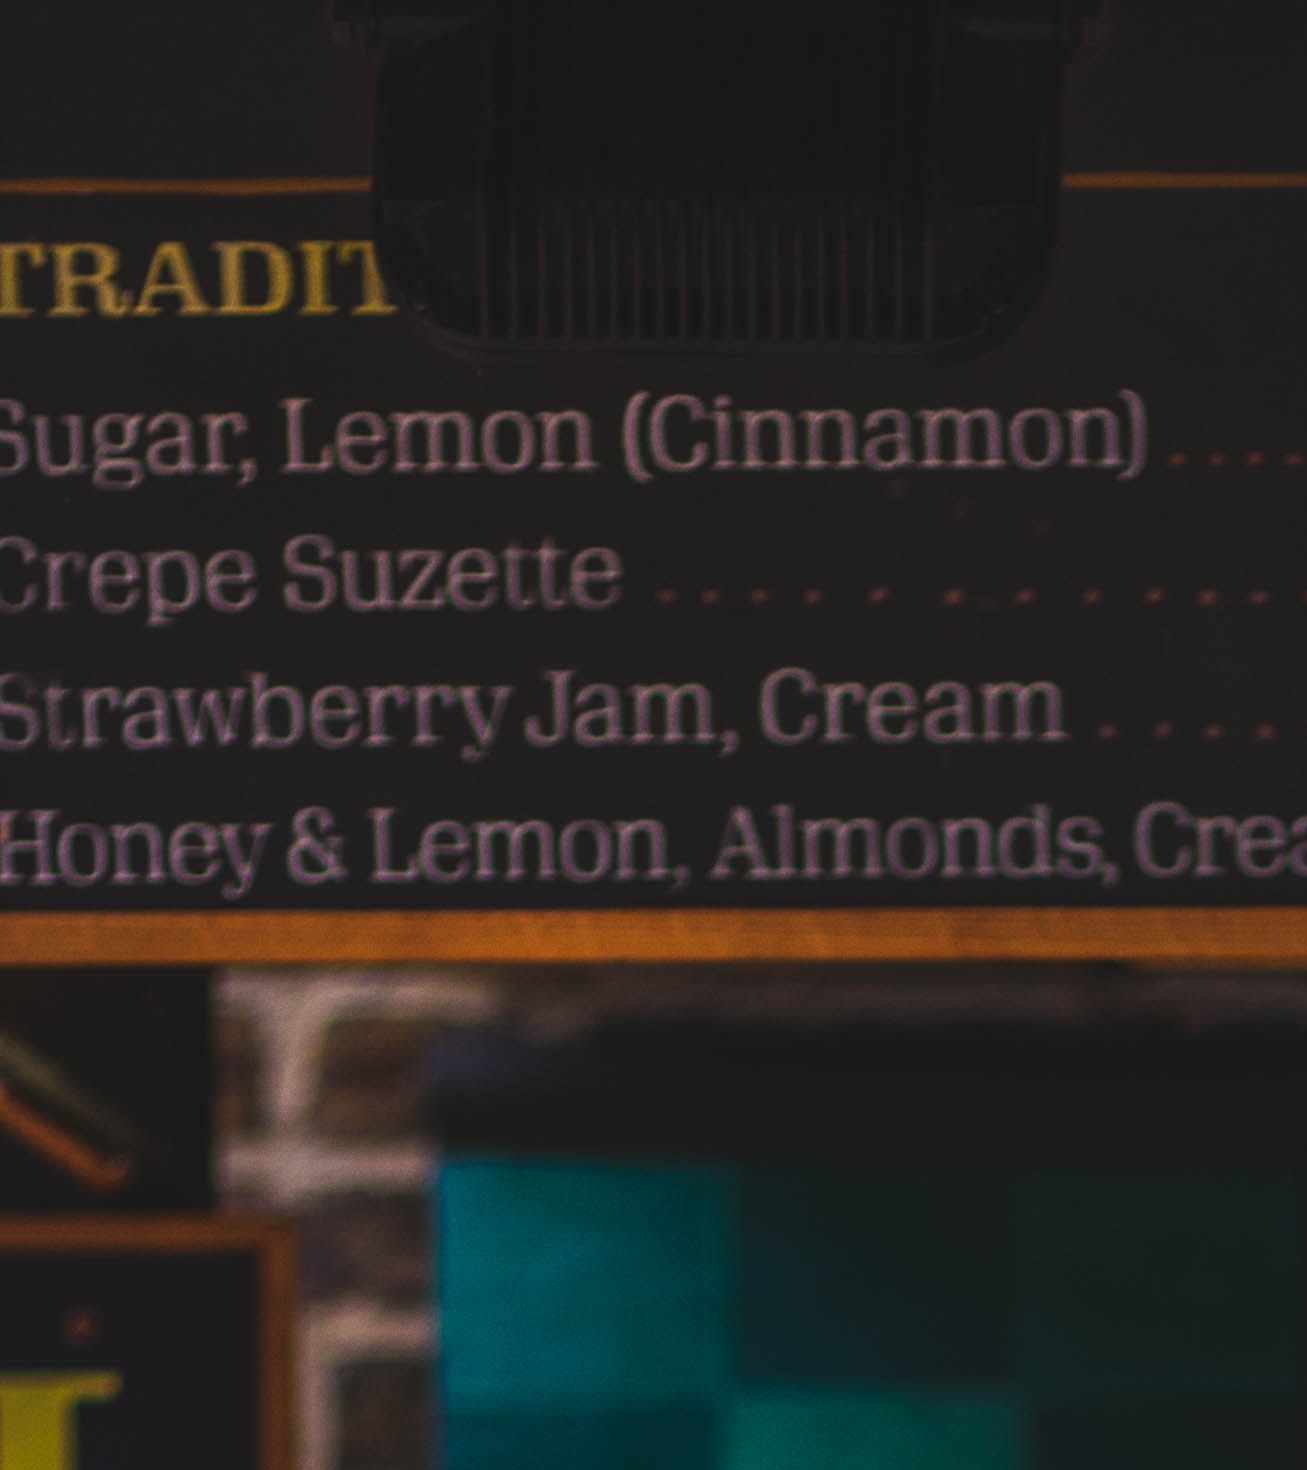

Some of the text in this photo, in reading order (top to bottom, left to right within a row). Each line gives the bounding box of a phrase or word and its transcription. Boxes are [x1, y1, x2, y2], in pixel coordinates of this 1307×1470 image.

[281, 396, 597, 474] Lemon
[620, 388, 1146, 483] (Cinnamon)
[0, 533, 622, 628] Crepe Suzette
[0, 665, 1068, 761] Strawberry Jam, Cream
[0, 807, 273, 899] Honey
[286, 805, 346, 885] &
[368, 805, 689, 891] Lemon,
[709, 802, 1119, 885] Almonds,
